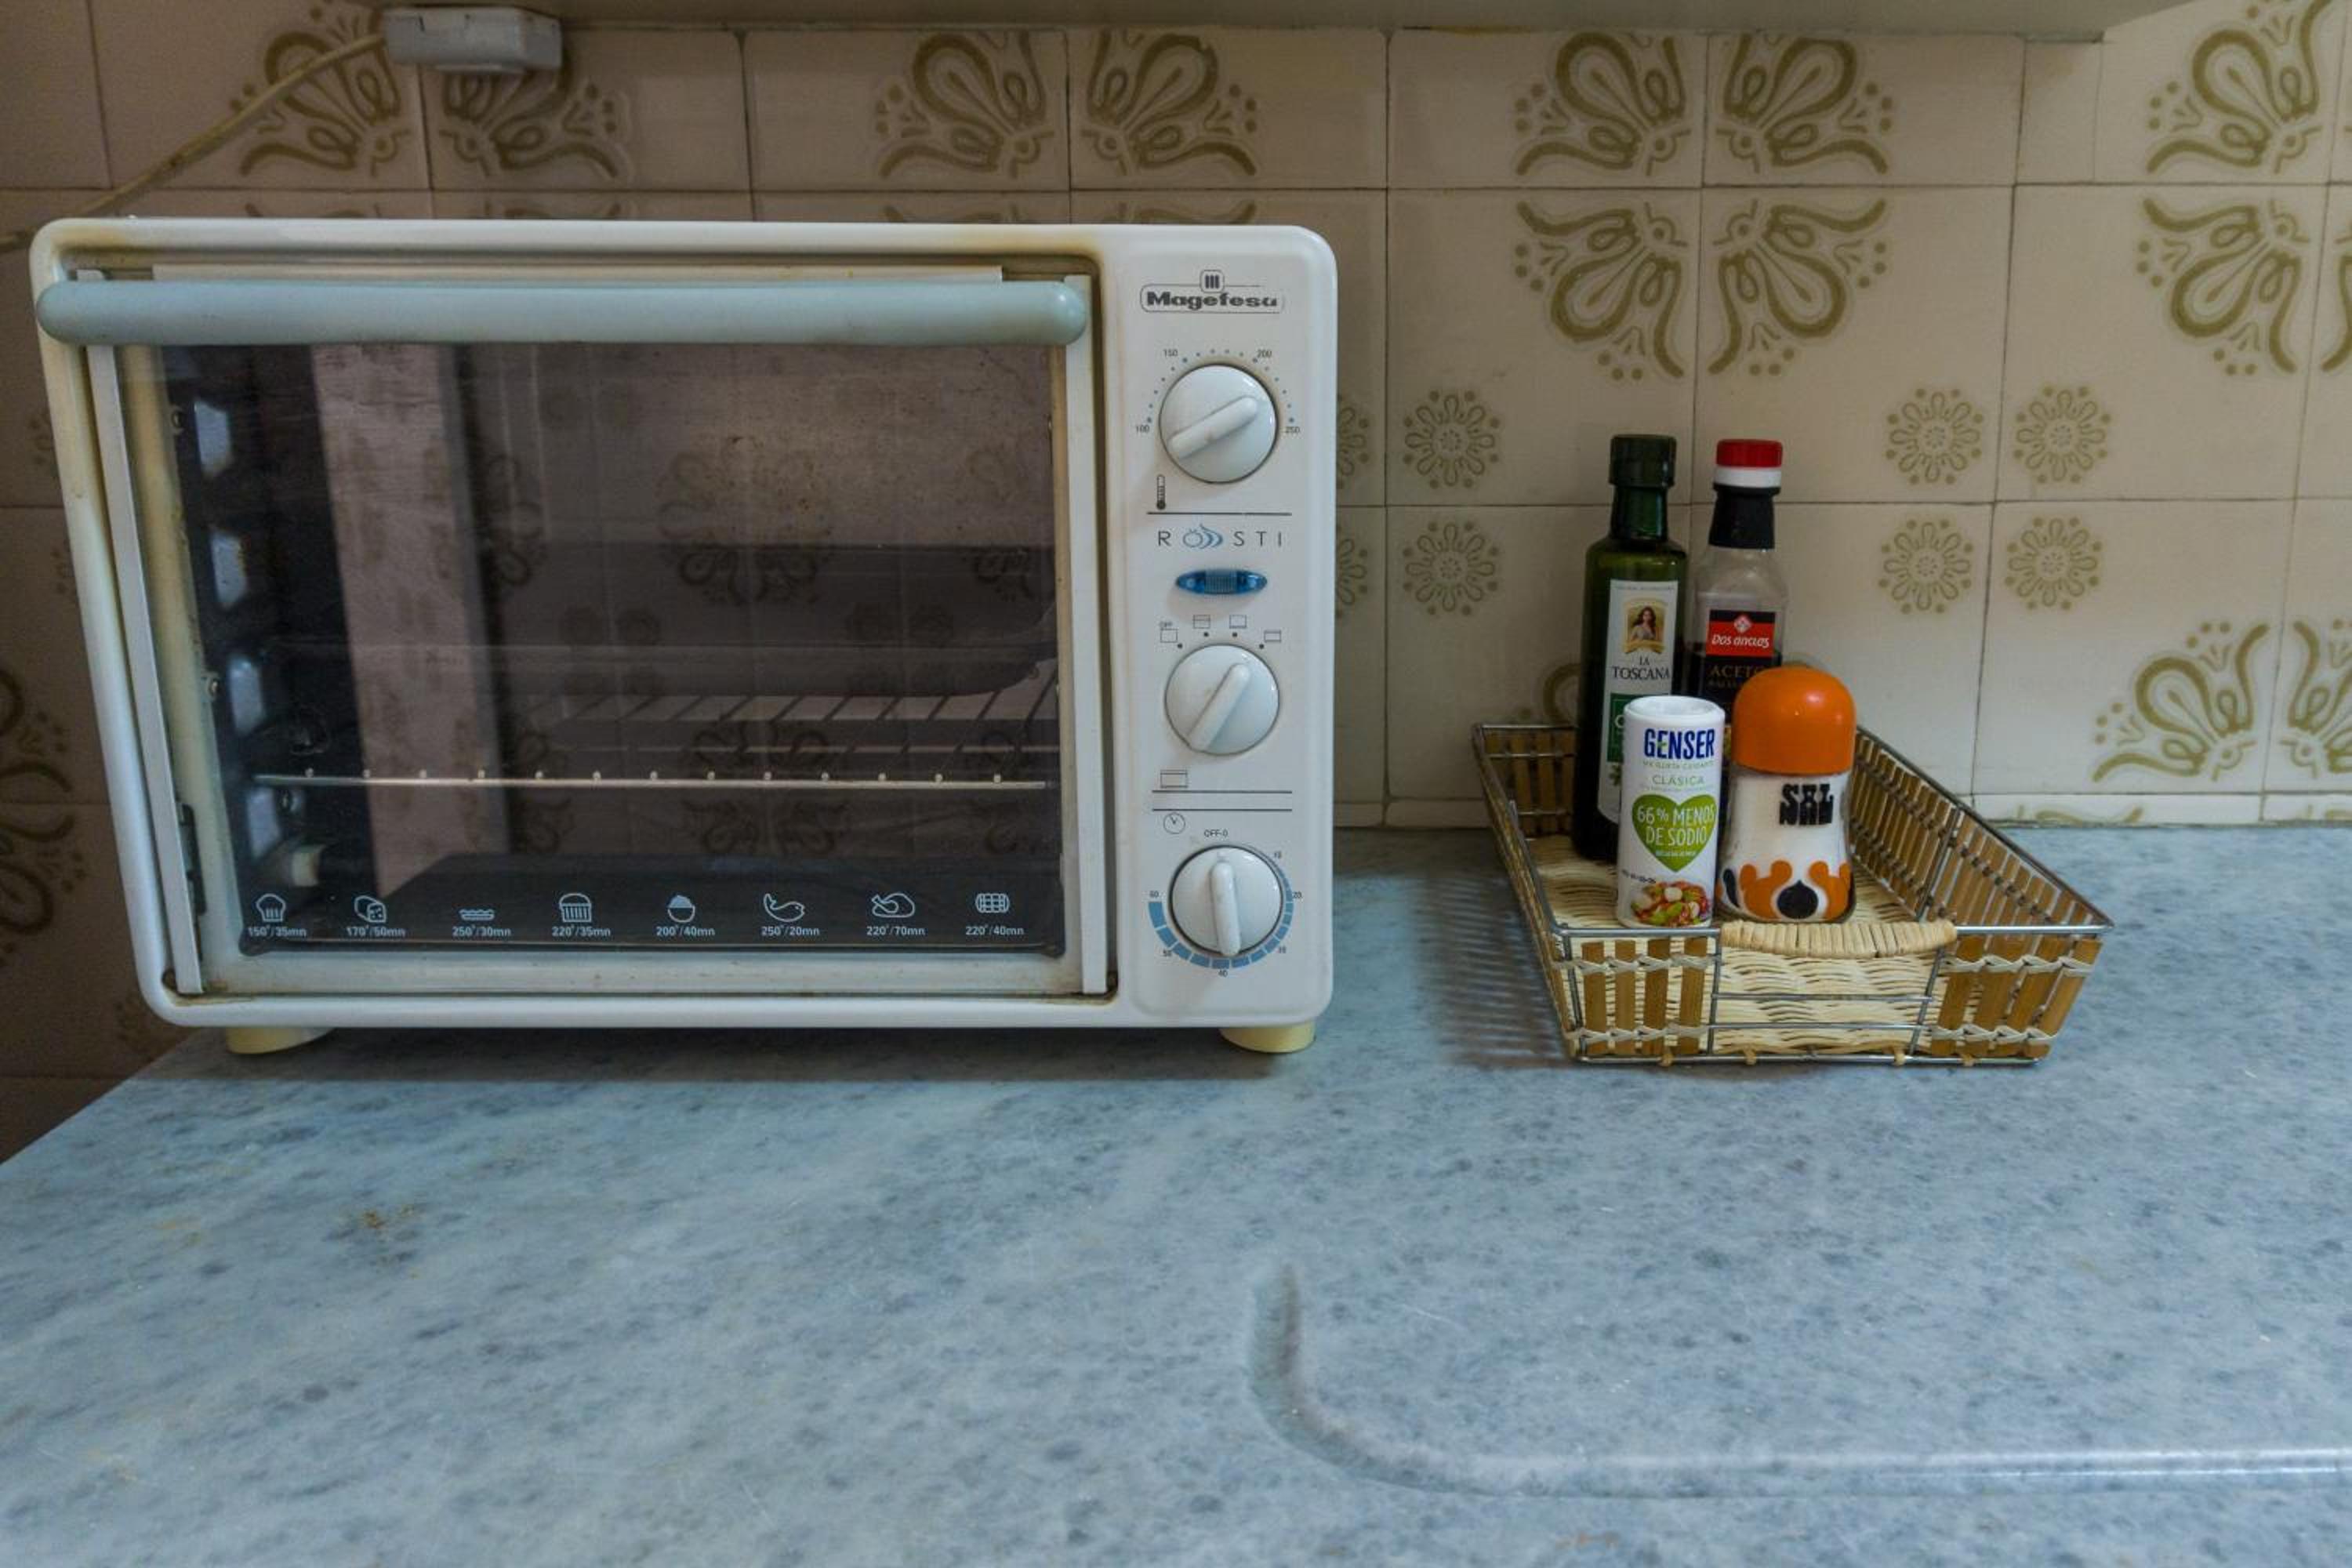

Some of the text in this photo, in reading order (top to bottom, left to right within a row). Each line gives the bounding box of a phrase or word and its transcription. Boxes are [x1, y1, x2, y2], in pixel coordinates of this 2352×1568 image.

[1147, 291, 1277, 310] Magefesa
[1639, 656, 1650, 666] LA
[1612, 666, 1670, 680] TOSCANA
[1644, 728, 1715, 760] GENSER
[1779, 783, 1833, 826] SAL
[1673, 805, 1715, 826] MENOS
[1646, 826, 1707, 846] DE SODIO
